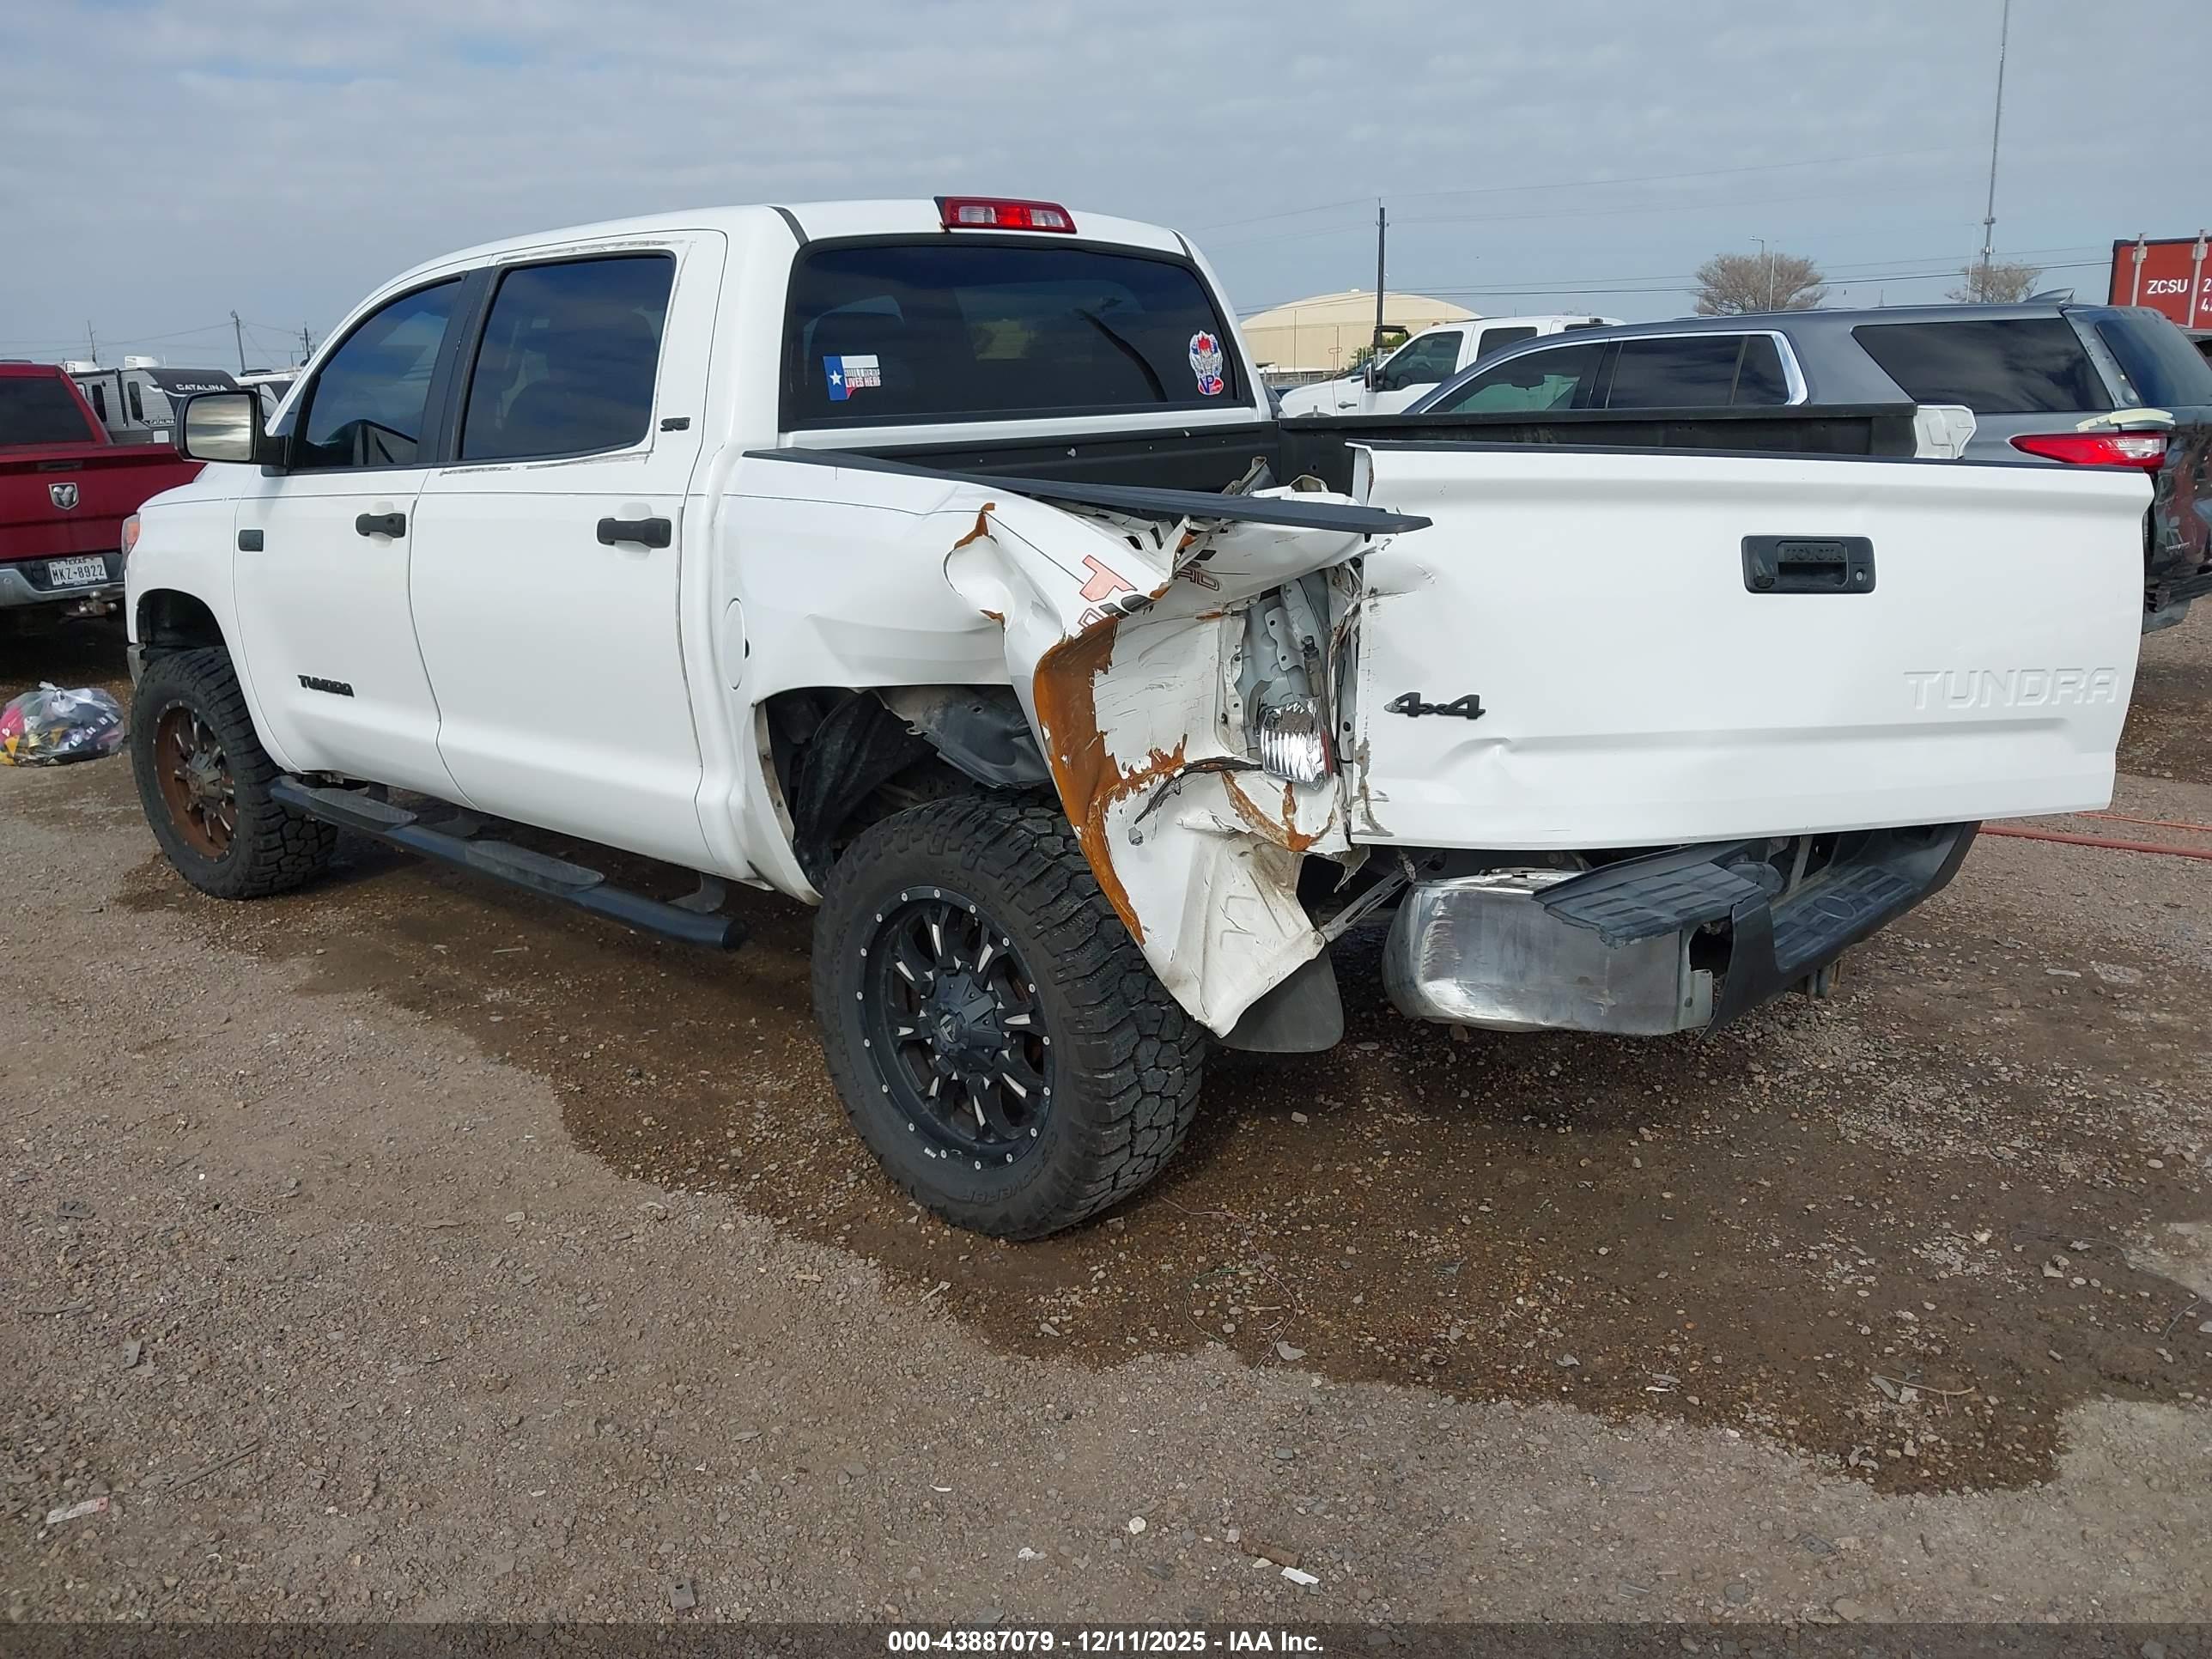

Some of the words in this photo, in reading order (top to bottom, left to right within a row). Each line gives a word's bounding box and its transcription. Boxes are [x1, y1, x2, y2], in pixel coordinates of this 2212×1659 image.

[2147, 278, 2189, 295] ZCSU
[175, 383, 228, 392] CATALINA
[1903, 666, 2119, 710] TUNDRA
[1383, 691, 1486, 720] 4x4
